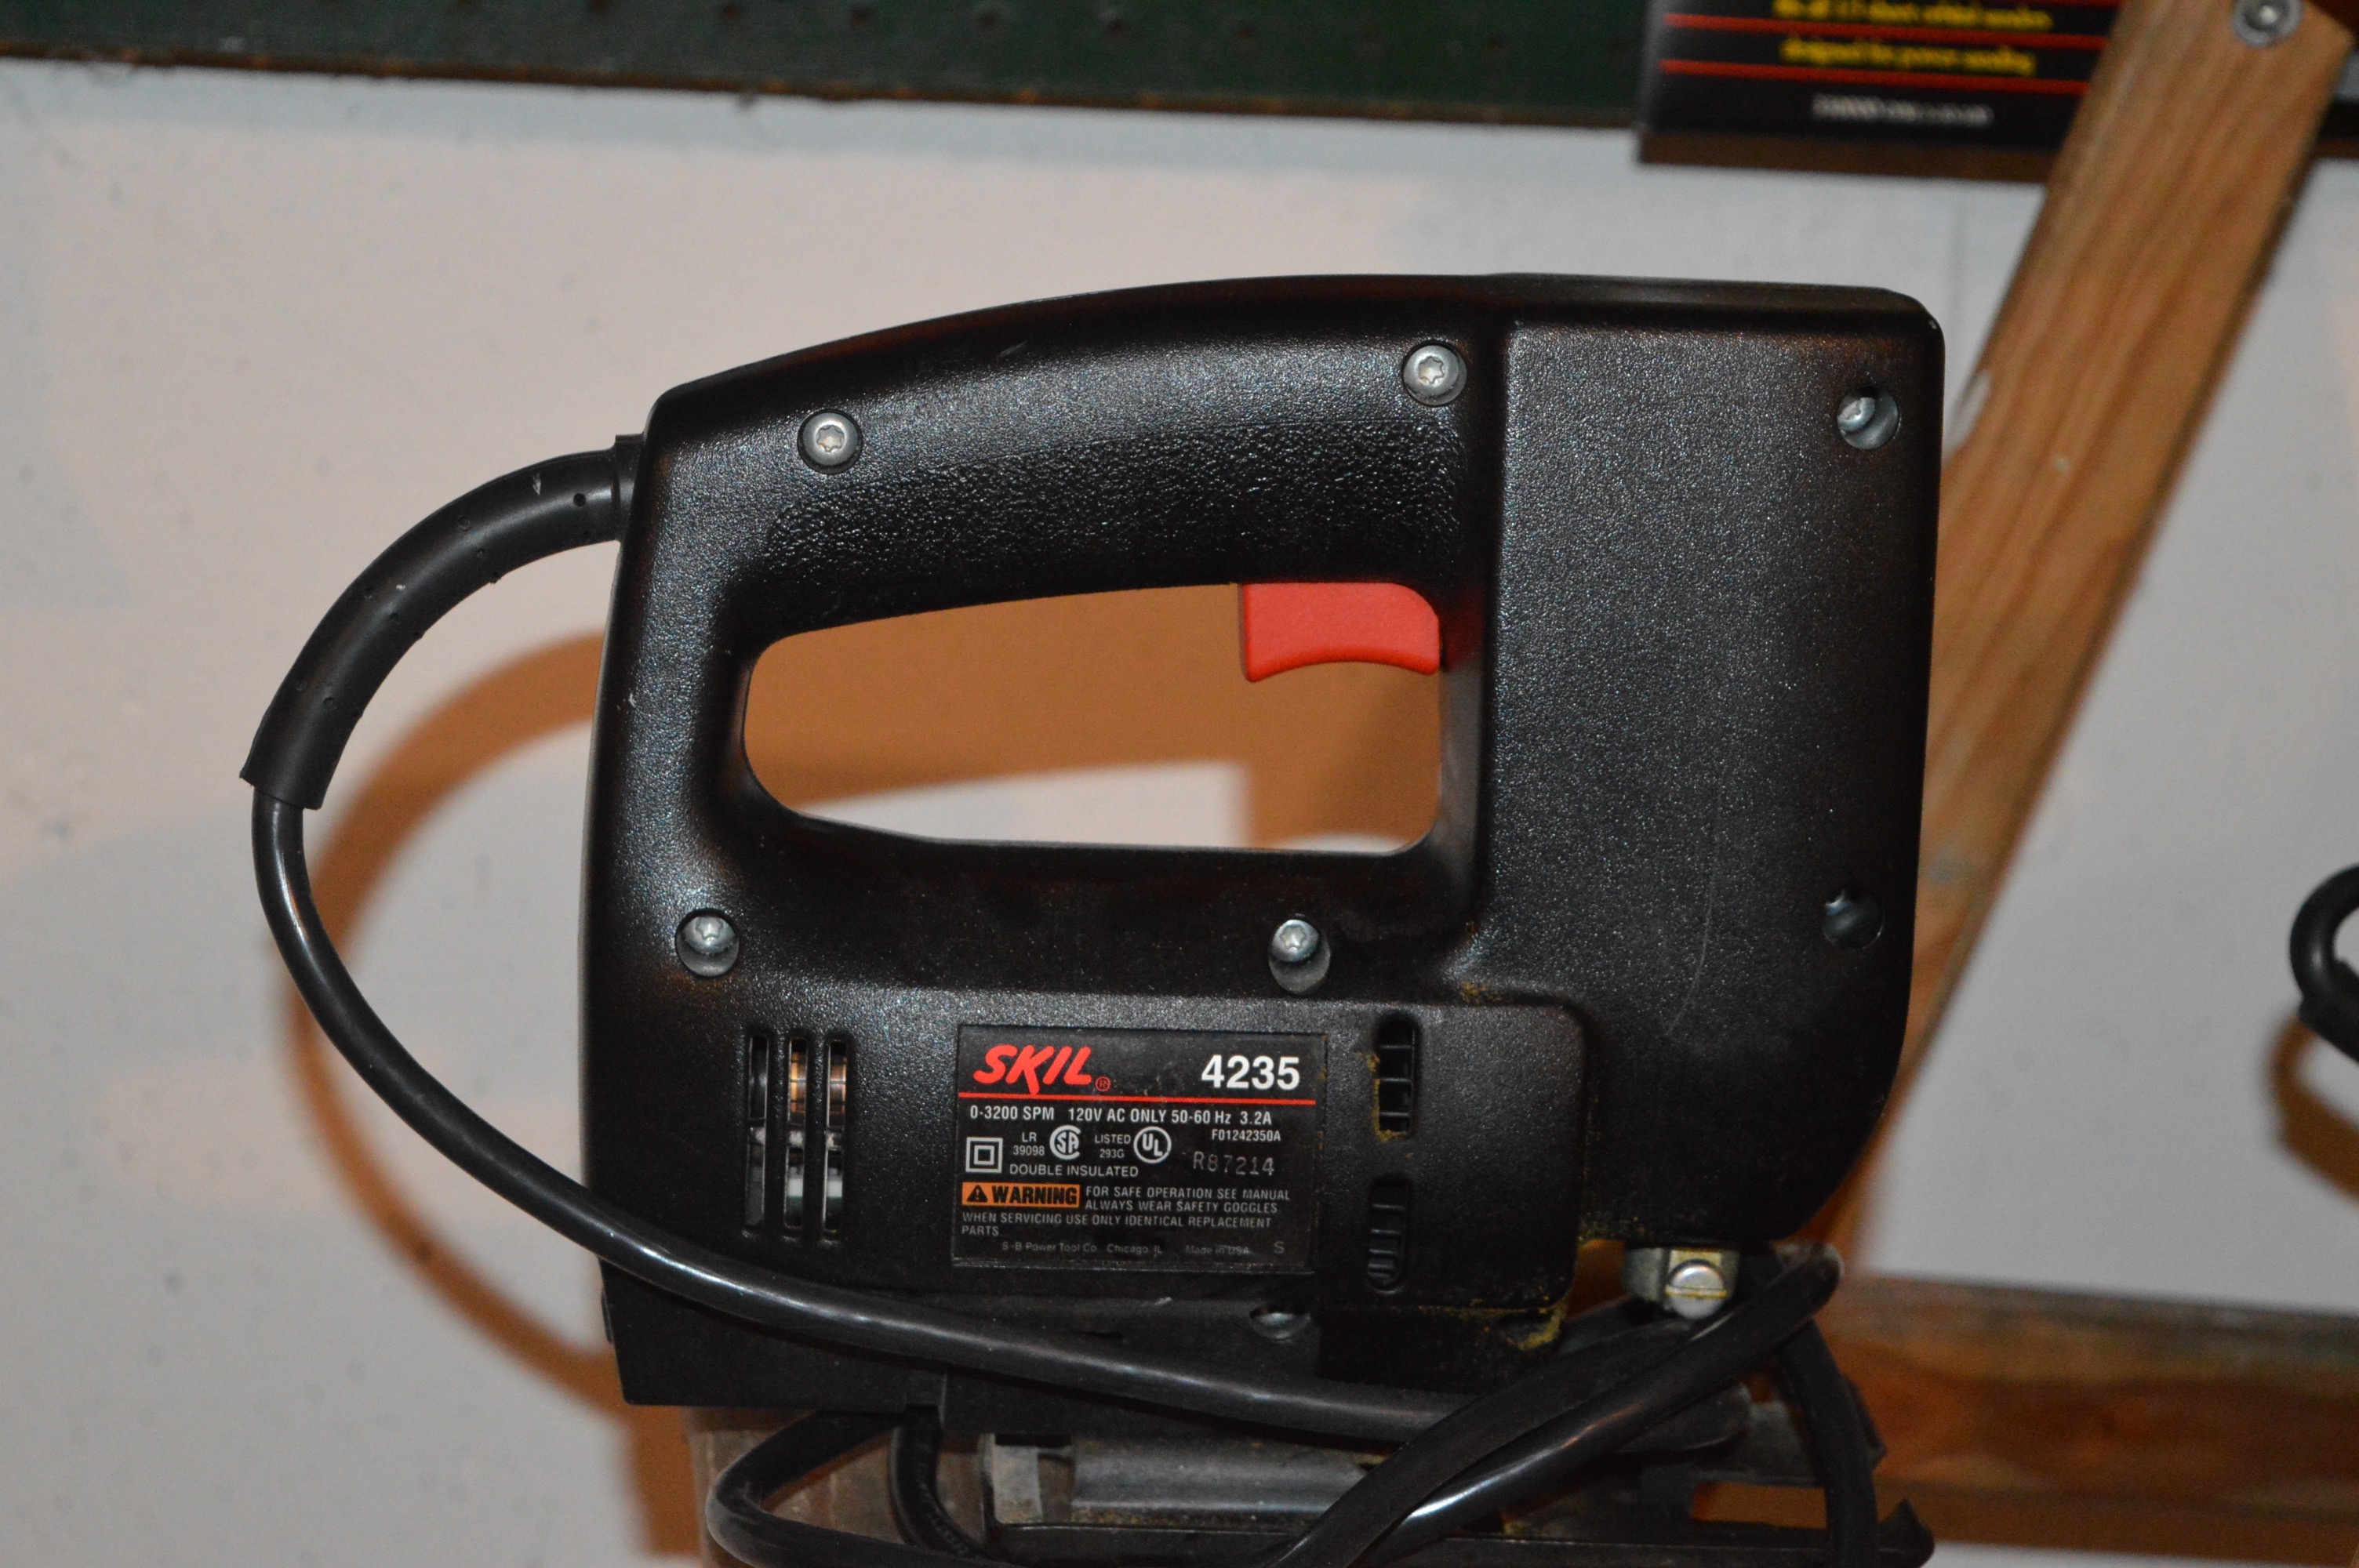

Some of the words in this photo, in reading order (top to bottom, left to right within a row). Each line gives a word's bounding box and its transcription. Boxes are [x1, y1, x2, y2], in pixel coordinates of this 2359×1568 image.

[973, 1045, 1092, 1095] SKIL
[1201, 1054, 1300, 1091] 4235
[970, 1105, 1018, 1121] 0-3200
[1023, 1106, 1055, 1121] SPM
[1069, 1108, 1103, 1123] 120V
[1107, 1109, 1126, 1123] AC
[1130, 1109, 1166, 1123] ONLY
[1171, 1109, 1211, 1124] 50-60
[1216, 1110, 1230, 1124] Hz
[1240, 1111, 1272, 1125] 3.2A
[1022, 1132, 1037, 1142] LR
[1095, 1134, 1131, 1145] LISTED
[1013, 1145, 1045, 1156] 39098
[1100, 1149, 1125, 1158] 293G
[1009, 1164, 1063, 1175] DOUBLE
[1067, 1165, 1139, 1177] INSULATED
[991, 1185, 1078, 1205] WARNING
[1086, 1186, 1109, 1196] FOR
[1114, 1187, 1141, 1197] SAFE
[1147, 1188, 1212, 1199] OPERATION
[1217, 1189, 1237, 1199] SEE
[1242, 1189, 1290, 1200] MANUAL
[1085, 1200, 1133, 1210] ALWAYS
[1139, 1201, 1171, 1211] WEAR
[1176, 1201, 1219, 1211] SAFETY
[1223, 1202, 1278, 1214] GOGGLES
[962, 1212, 997, 1222] WHEN
[1000, 1213, 1062, 1224] SERVICING
[1066, 1214, 1088, 1225] USE
[1092, 1214, 1121, 1225] ONLY
[1125, 1215, 1183, 1226] IDENTICAL
[1188, 1217, 1271, 1228] REPLACEMENT
[961, 1225, 999, 1236] PARTS
[1026, 1242, 1056, 1251] Power
